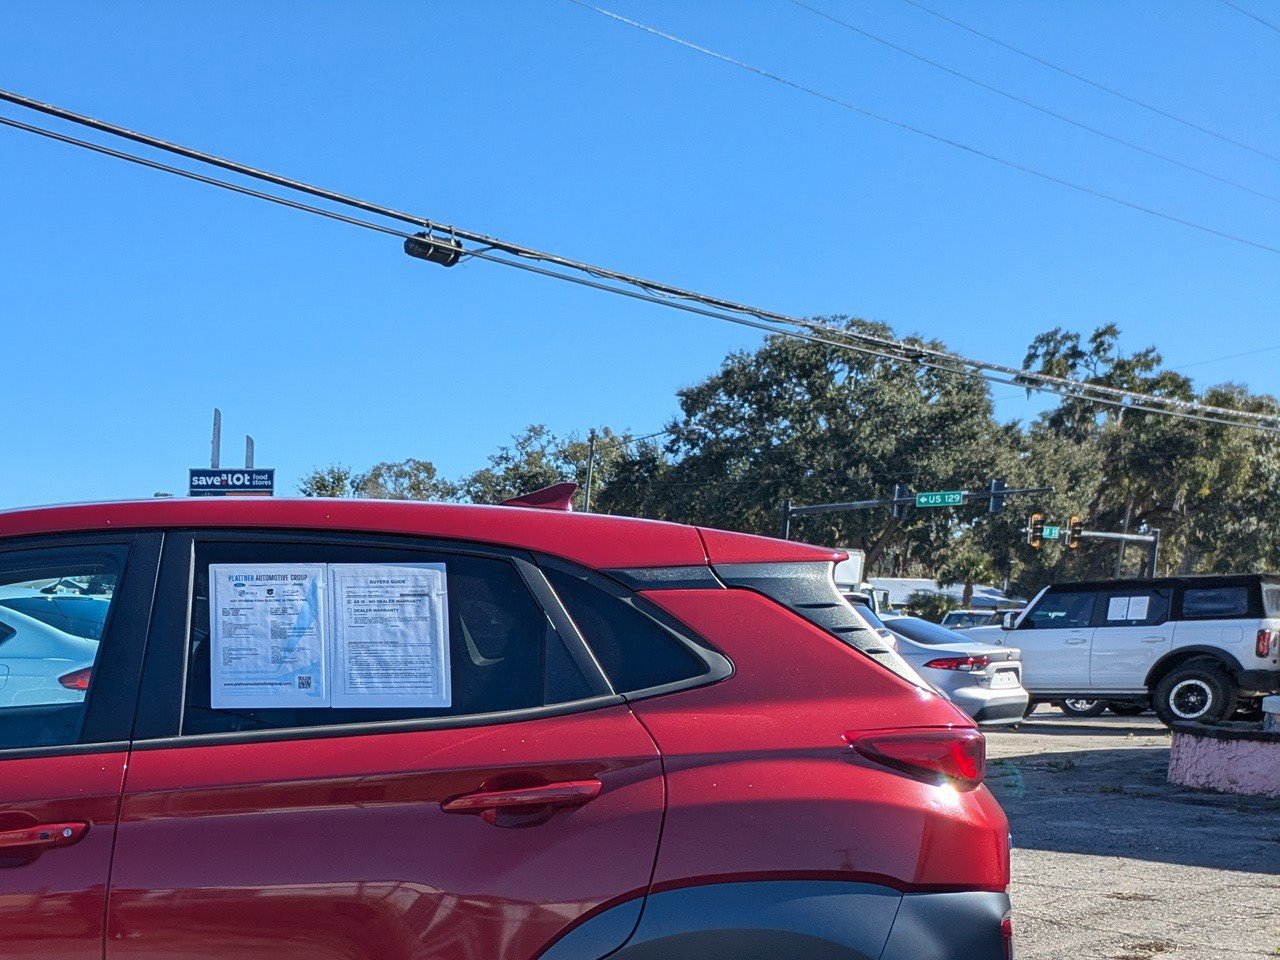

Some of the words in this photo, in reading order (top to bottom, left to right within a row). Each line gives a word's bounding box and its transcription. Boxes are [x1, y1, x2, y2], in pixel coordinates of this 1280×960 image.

[928, 496, 942, 504] US
[945, 495, 960, 503] 129
[228, 574, 254, 582] PLATTNER
